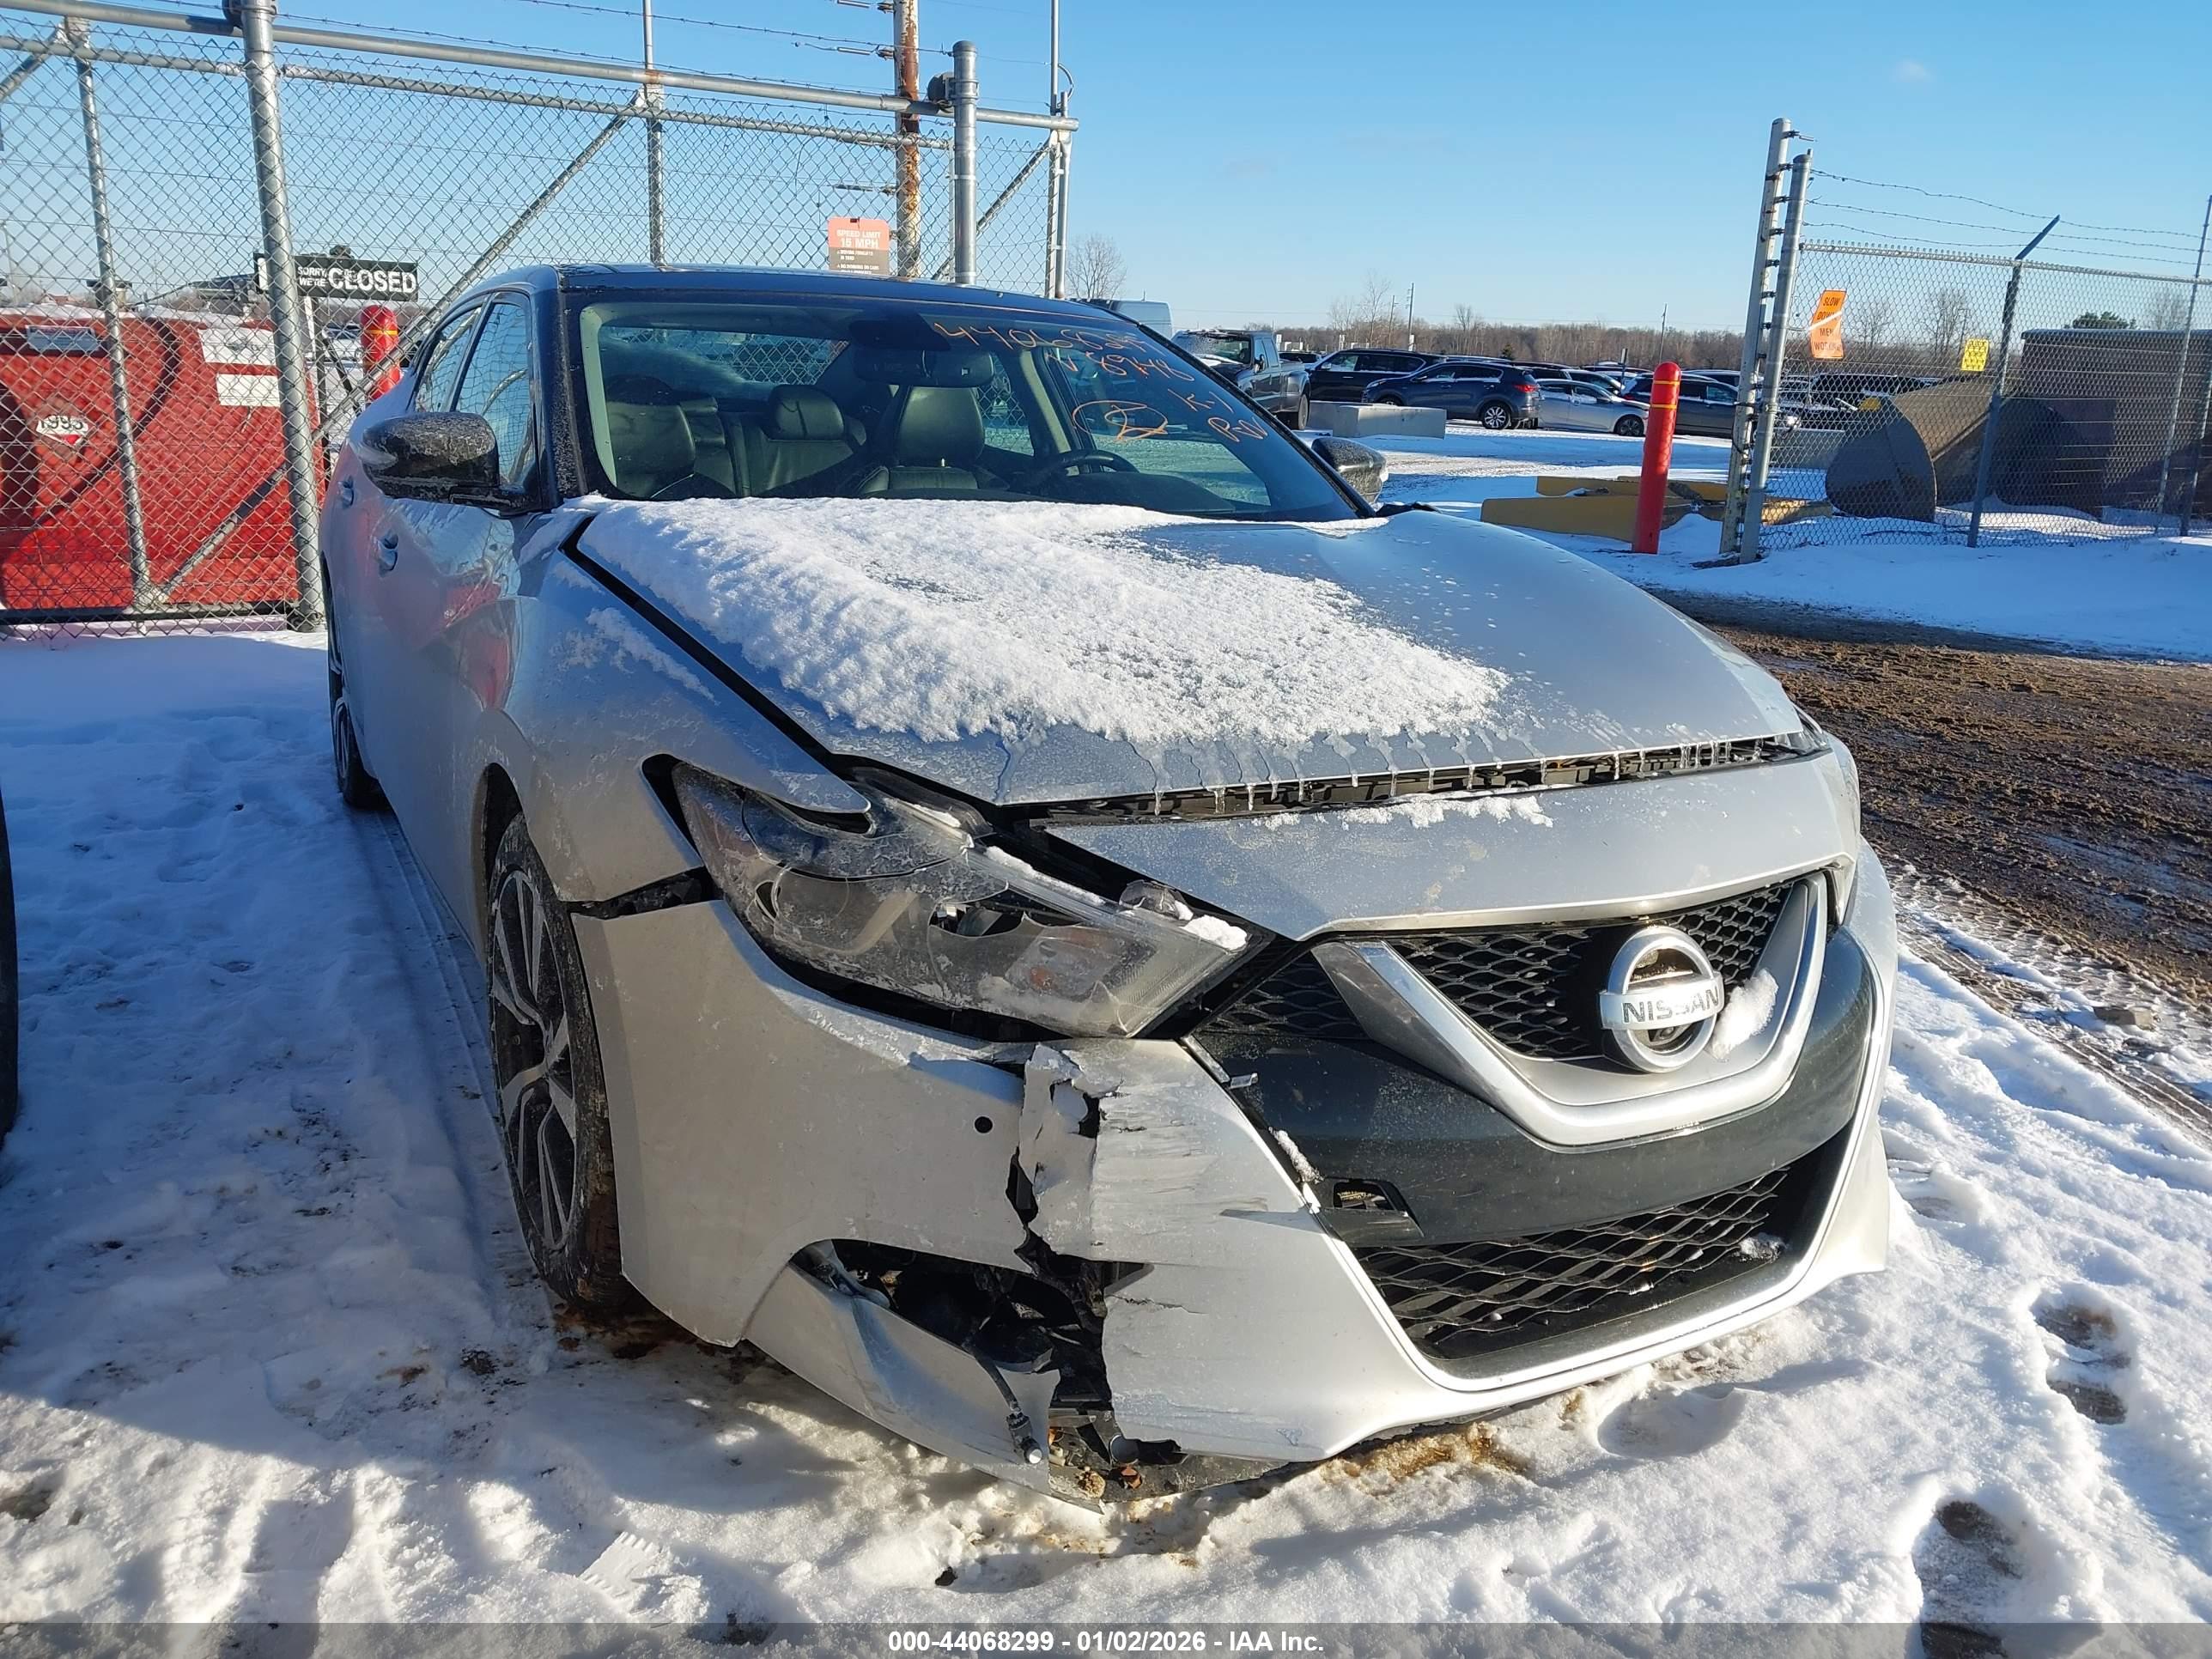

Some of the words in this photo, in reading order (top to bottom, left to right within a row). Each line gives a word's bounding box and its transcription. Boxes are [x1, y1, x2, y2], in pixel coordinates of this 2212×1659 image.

[855, 238, 878, 249] MPH
[328, 267, 416, 293] CLOSED
[1822, 296, 1841, 307] SLOW
[1820, 327, 1834, 337] MEN
[1622, 987, 1719, 1024] NISSAN
